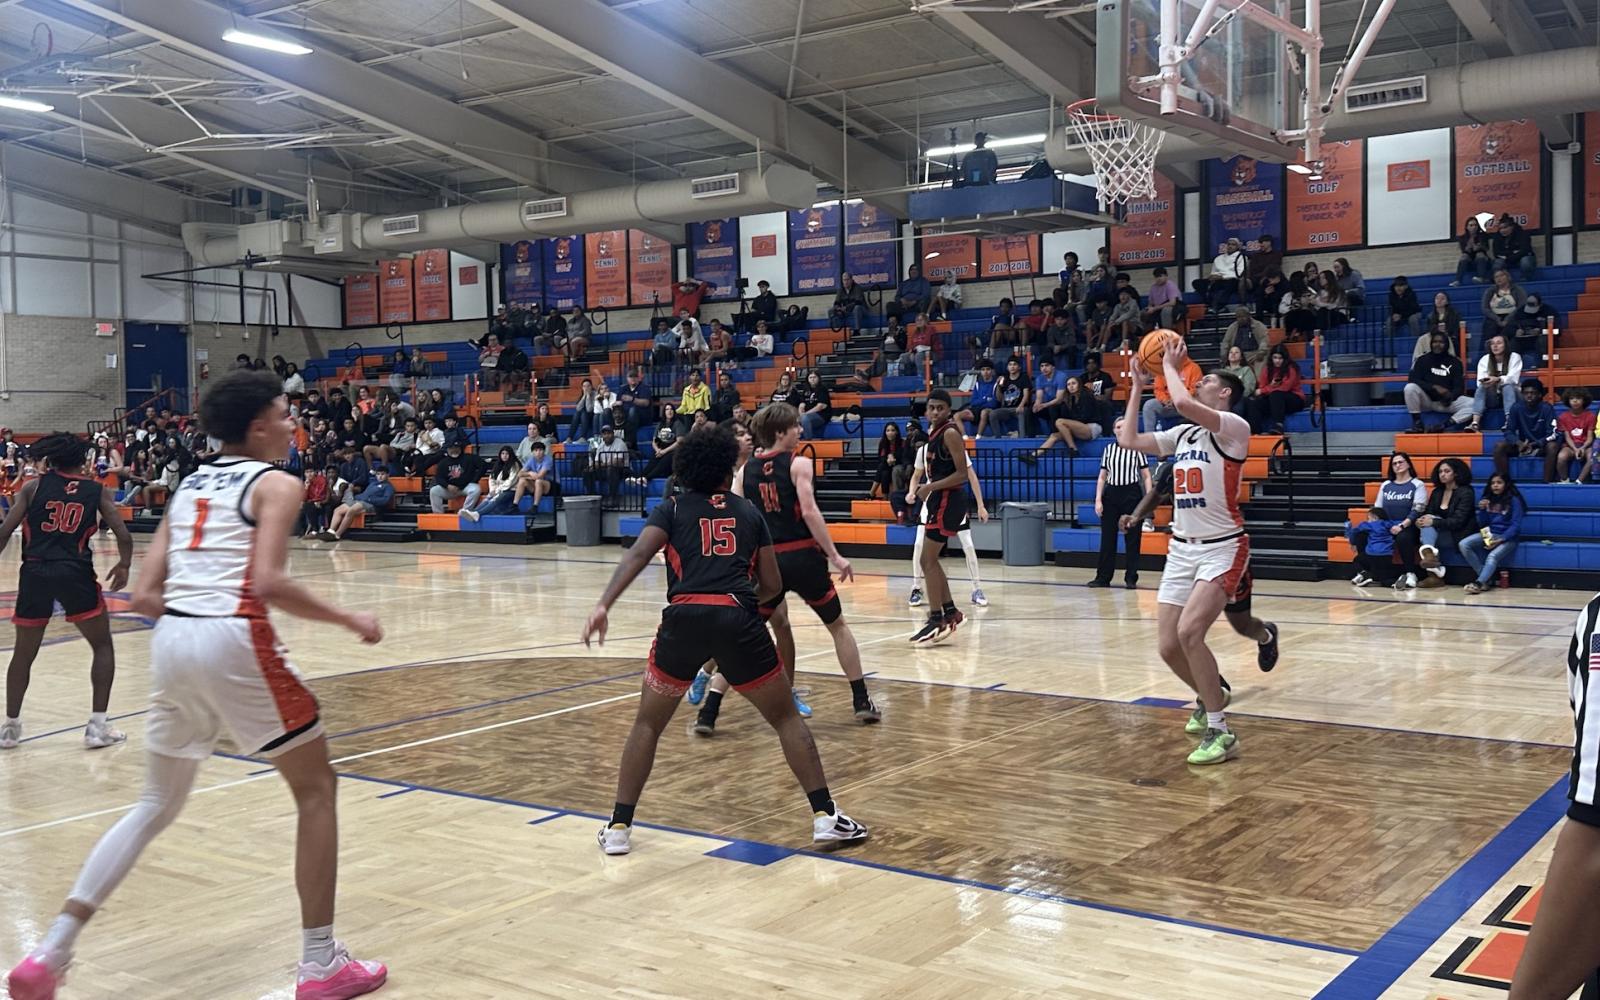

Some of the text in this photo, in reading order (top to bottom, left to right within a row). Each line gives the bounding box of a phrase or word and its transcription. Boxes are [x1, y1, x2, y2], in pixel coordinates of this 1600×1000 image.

[1465, 162, 1530, 177] SOFTBALL
[1308, 181, 1338, 194] GOLF
[1216, 189, 1274, 206] BASEBALL
[1127, 201, 1169, 214] IMMING
[1309, 232, 1338, 244] 2019
[1120, 249, 1166, 261] 2018-2019
[594, 258, 618, 268] TENNIS
[989, 261, 1031, 272] 20172018
[1175, 467, 1204, 494] 20
[41, 501, 84, 533] 30
[188, 498, 212, 550] 1
[700, 517, 736, 556] 15
